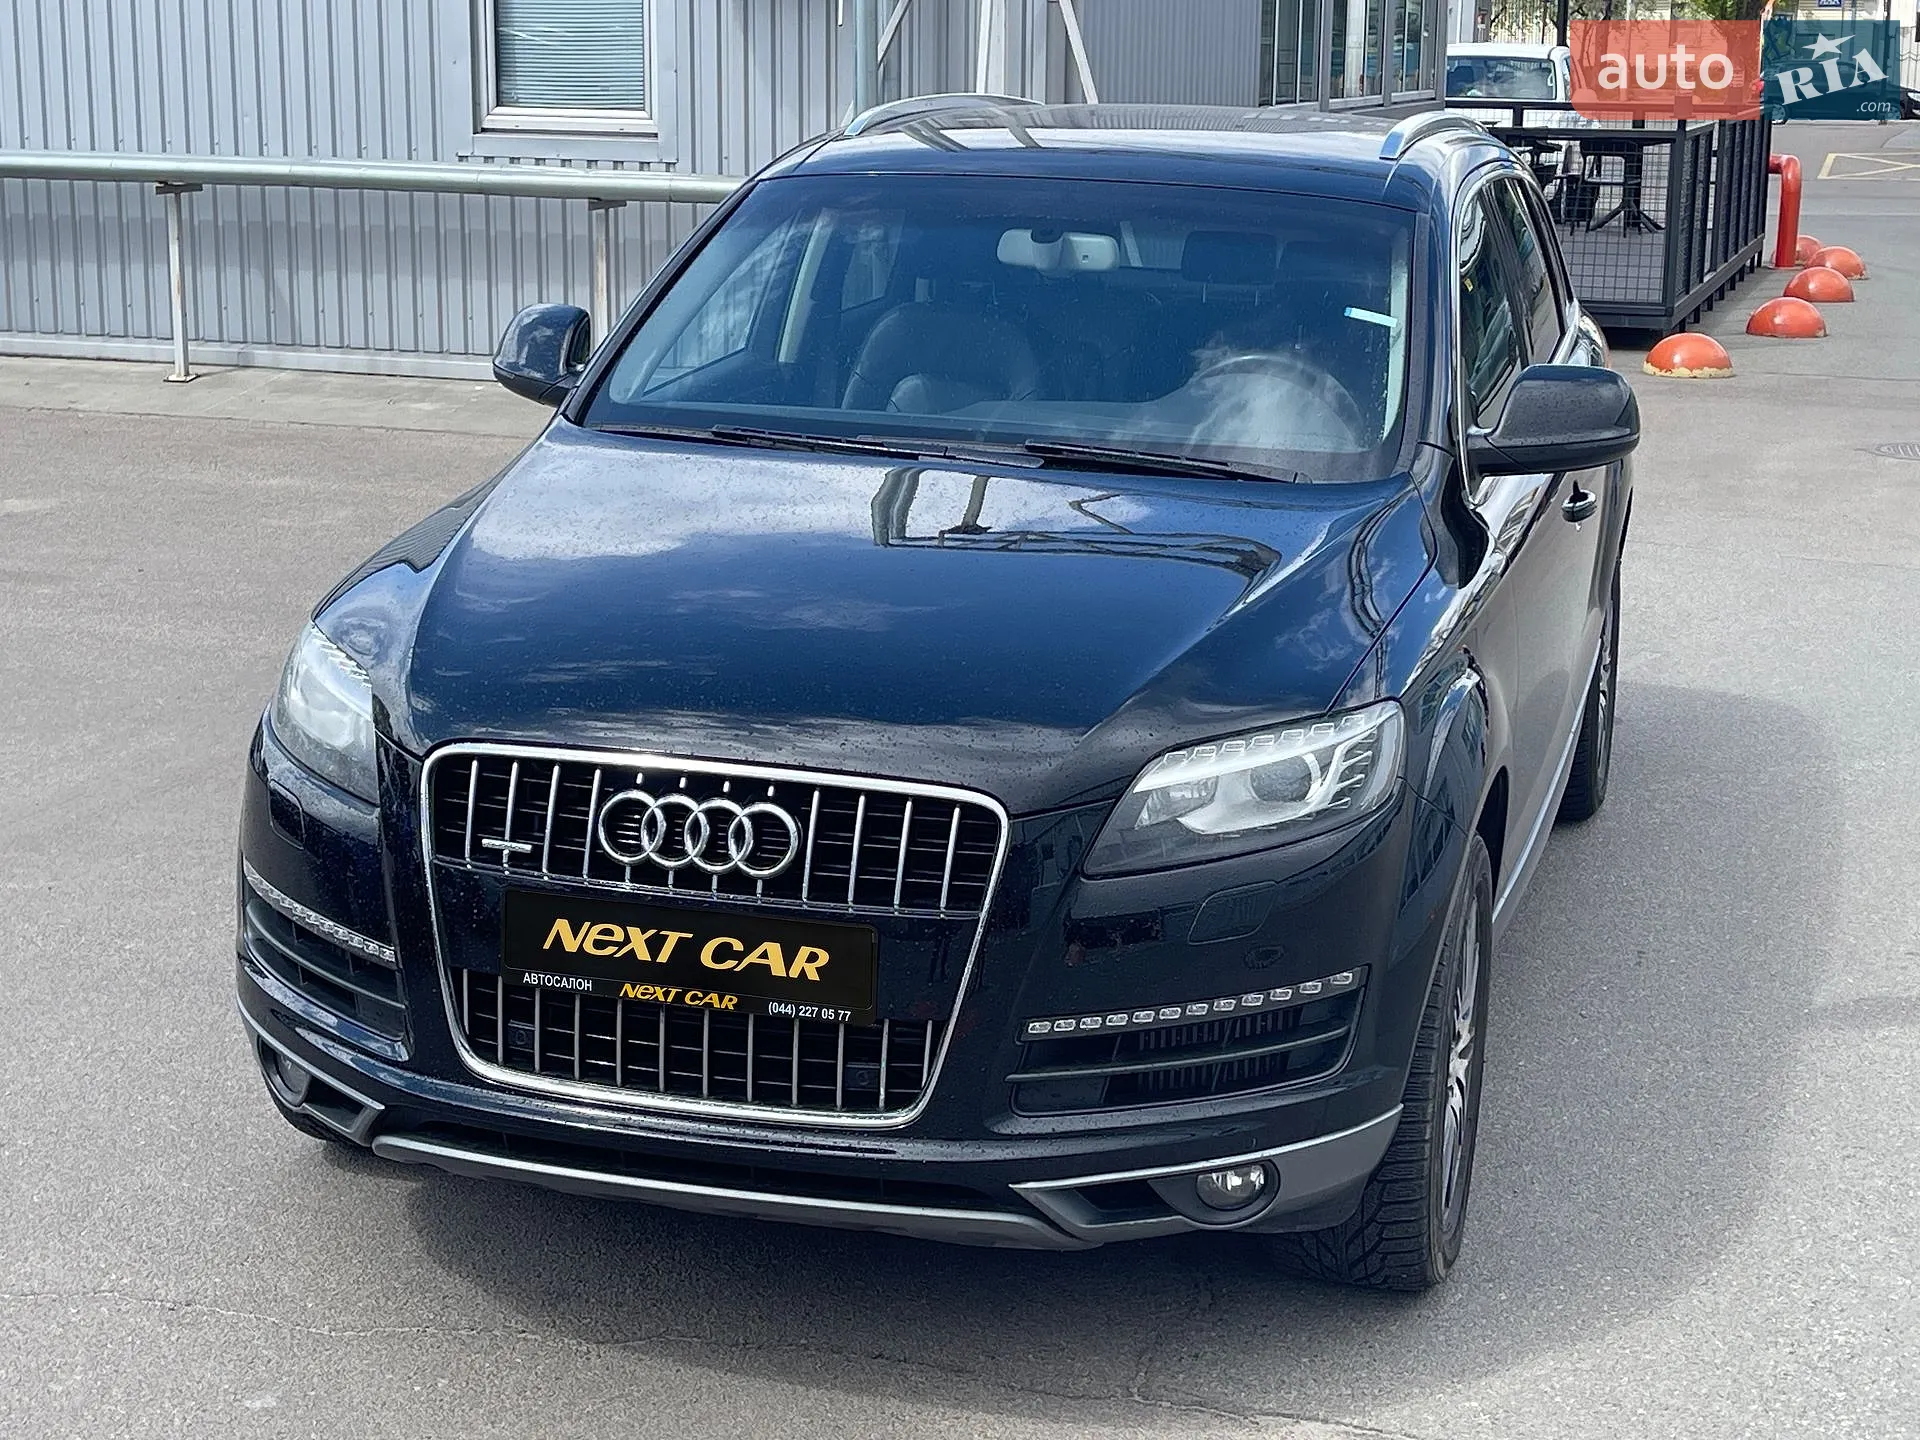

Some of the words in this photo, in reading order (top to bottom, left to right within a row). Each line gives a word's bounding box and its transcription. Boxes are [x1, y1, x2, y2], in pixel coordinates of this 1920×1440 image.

[700, 937, 829, 981] CAR
[523, 972, 593, 992] АВТОСАЛОН
[684, 990, 738, 1010] CAR
[768, 1001, 796, 1018] (044)
[799, 1005, 819, 1019] 227
[821, 1007, 835, 1020] 05
[837, 1009, 852, 1022] 77
